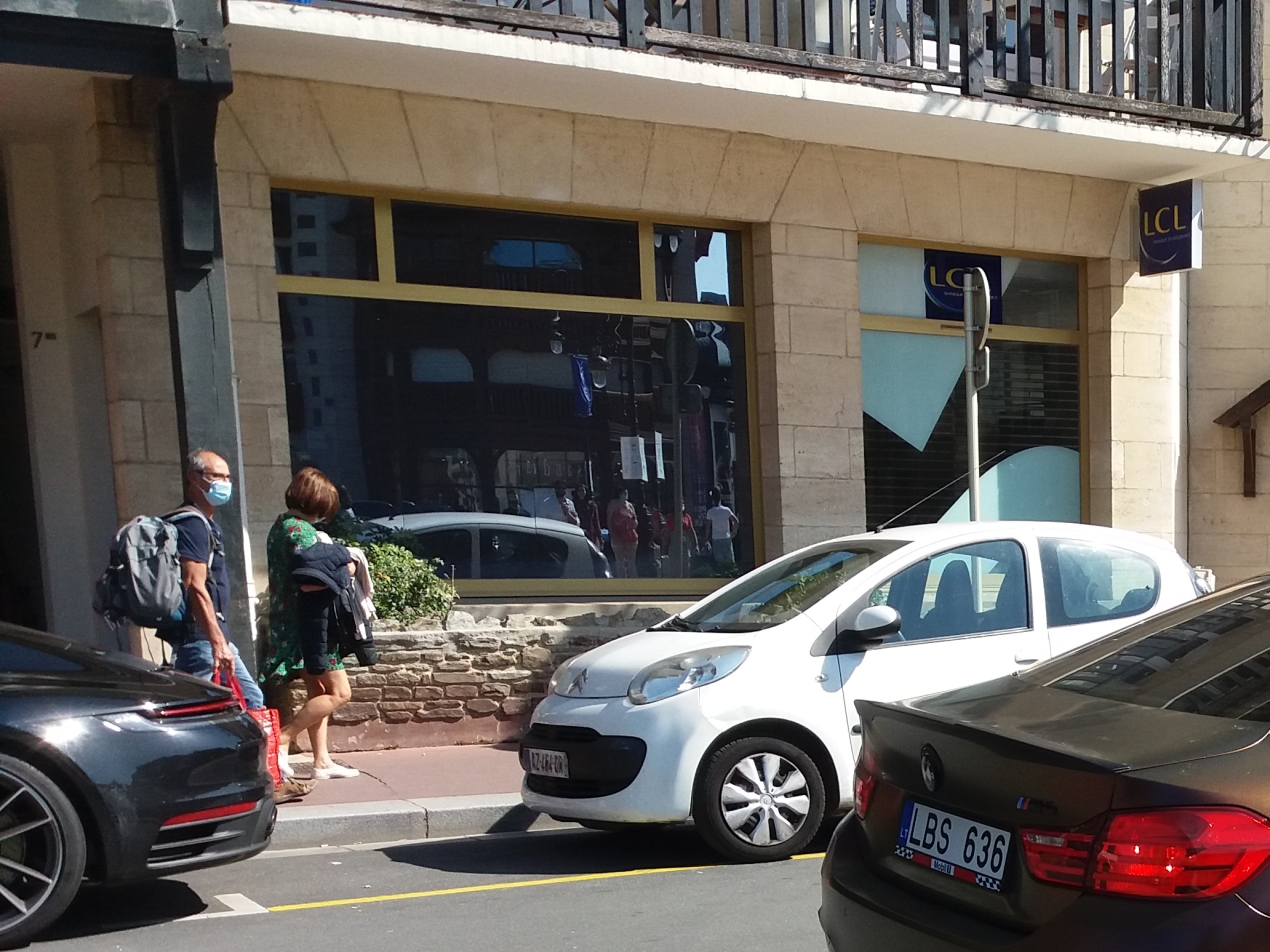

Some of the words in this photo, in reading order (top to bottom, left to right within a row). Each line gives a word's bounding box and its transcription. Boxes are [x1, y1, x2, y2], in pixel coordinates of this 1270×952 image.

[1144, 205, 1186, 236] LCL
[930, 266, 964, 289] LC
[900, 828, 909, 838] LT
[909, 808, 952, 855] LBS
[963, 826, 1006, 873] 636
